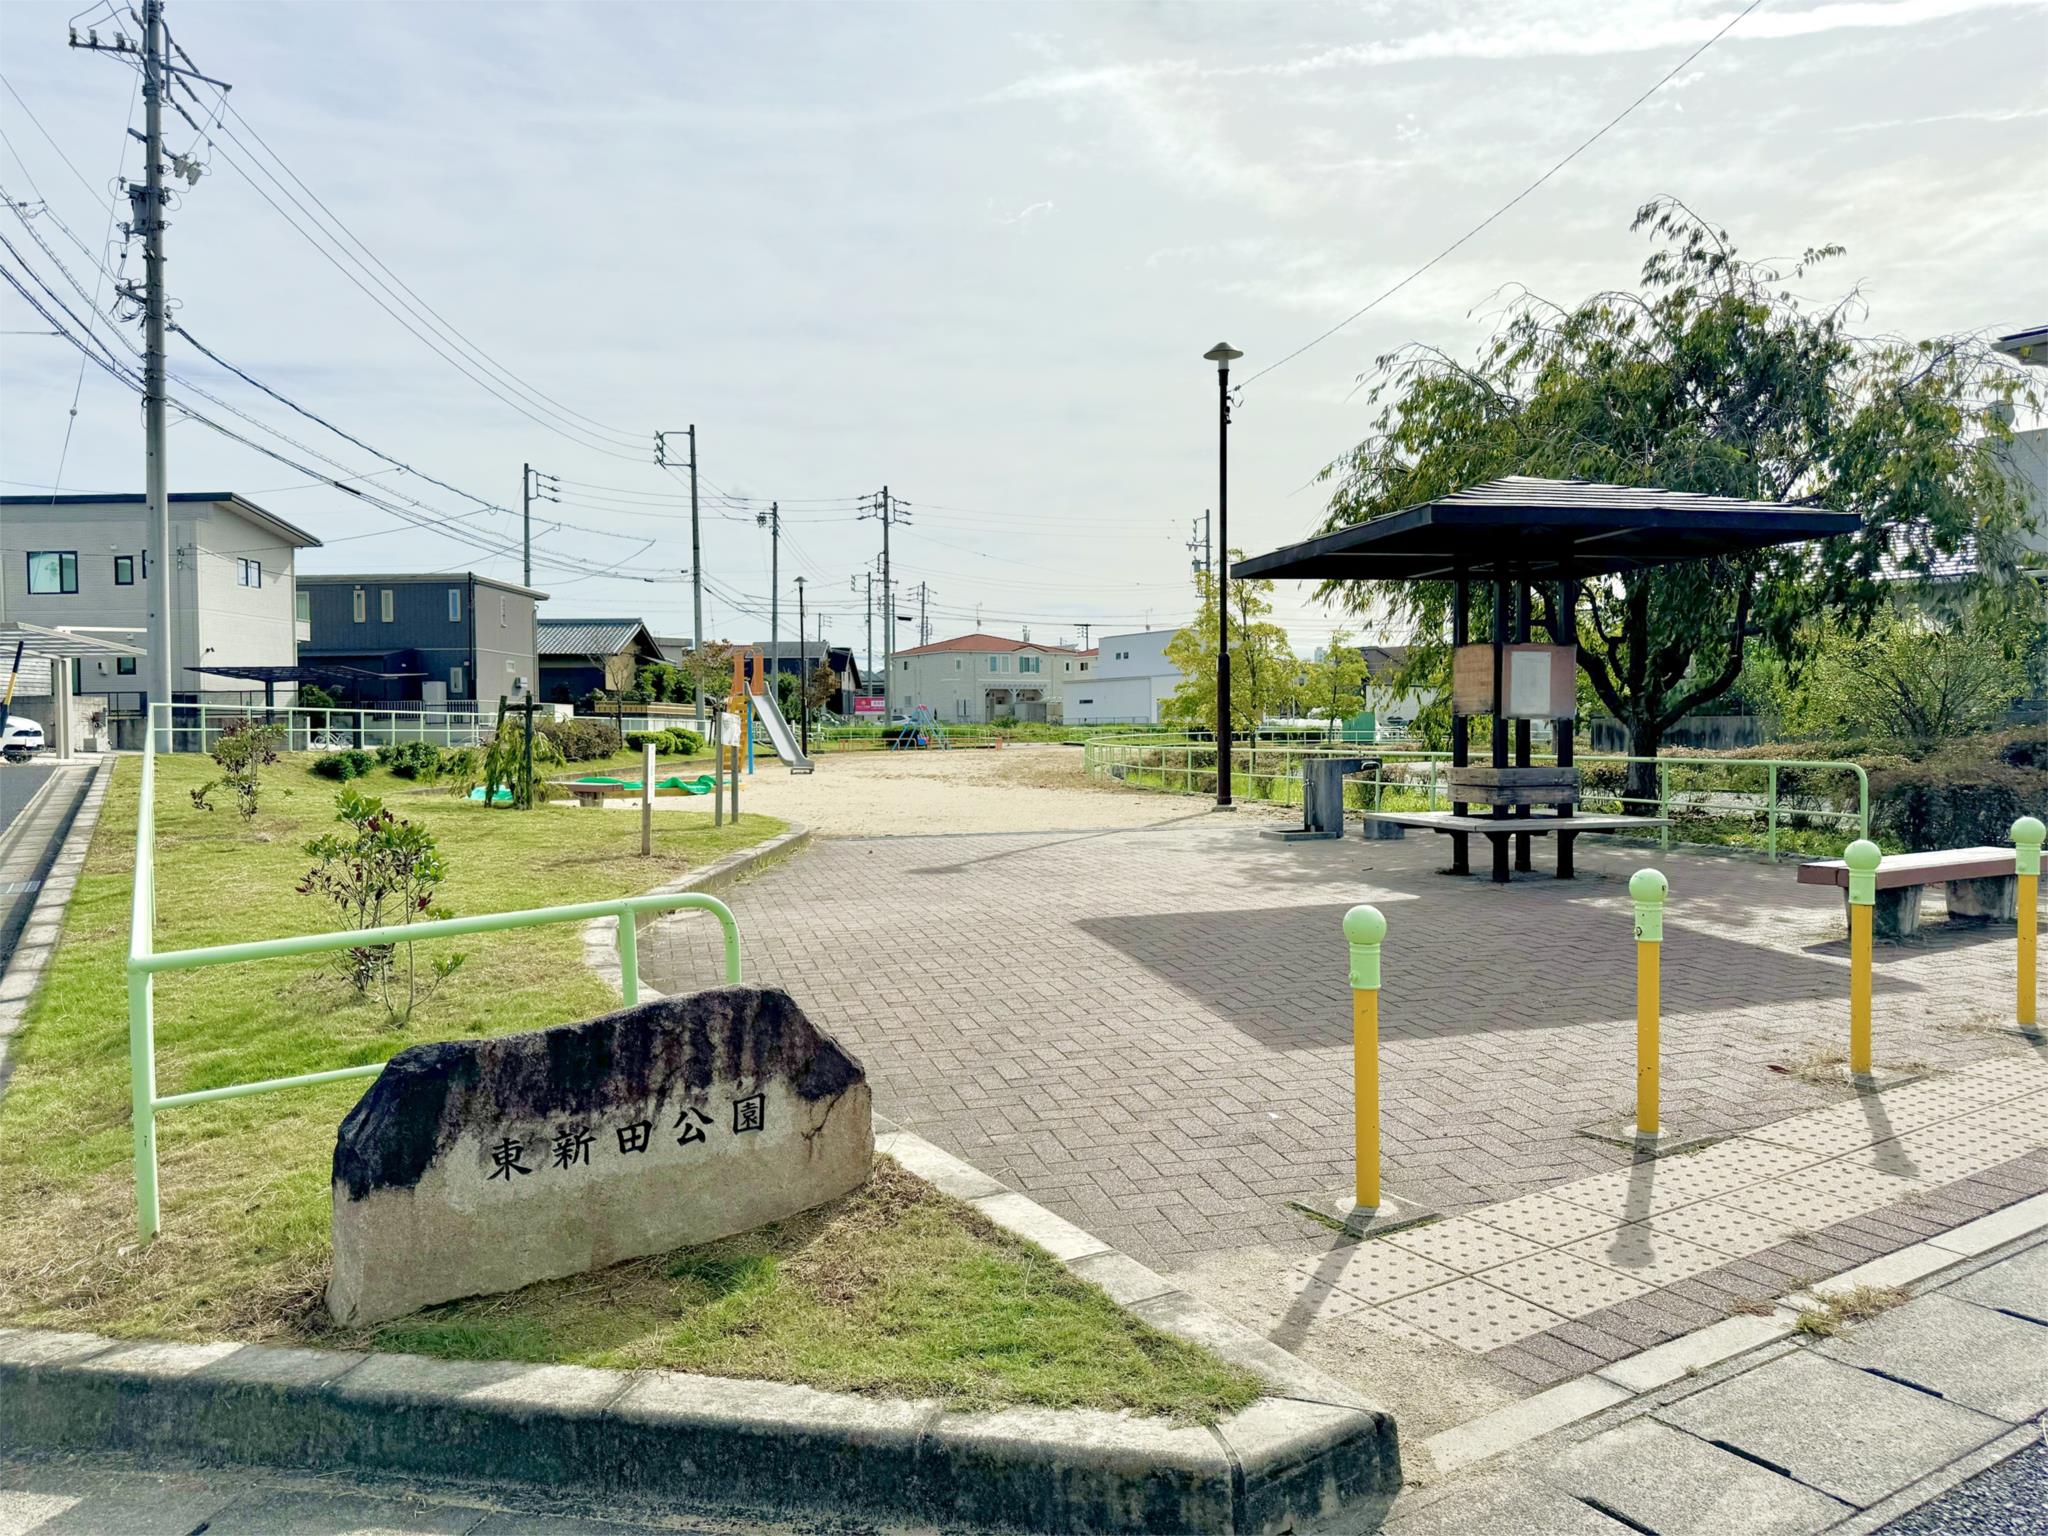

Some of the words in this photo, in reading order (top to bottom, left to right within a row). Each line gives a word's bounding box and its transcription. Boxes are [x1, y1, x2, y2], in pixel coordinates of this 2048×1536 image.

[486, 1092, 766, 1181] 東新田公園
